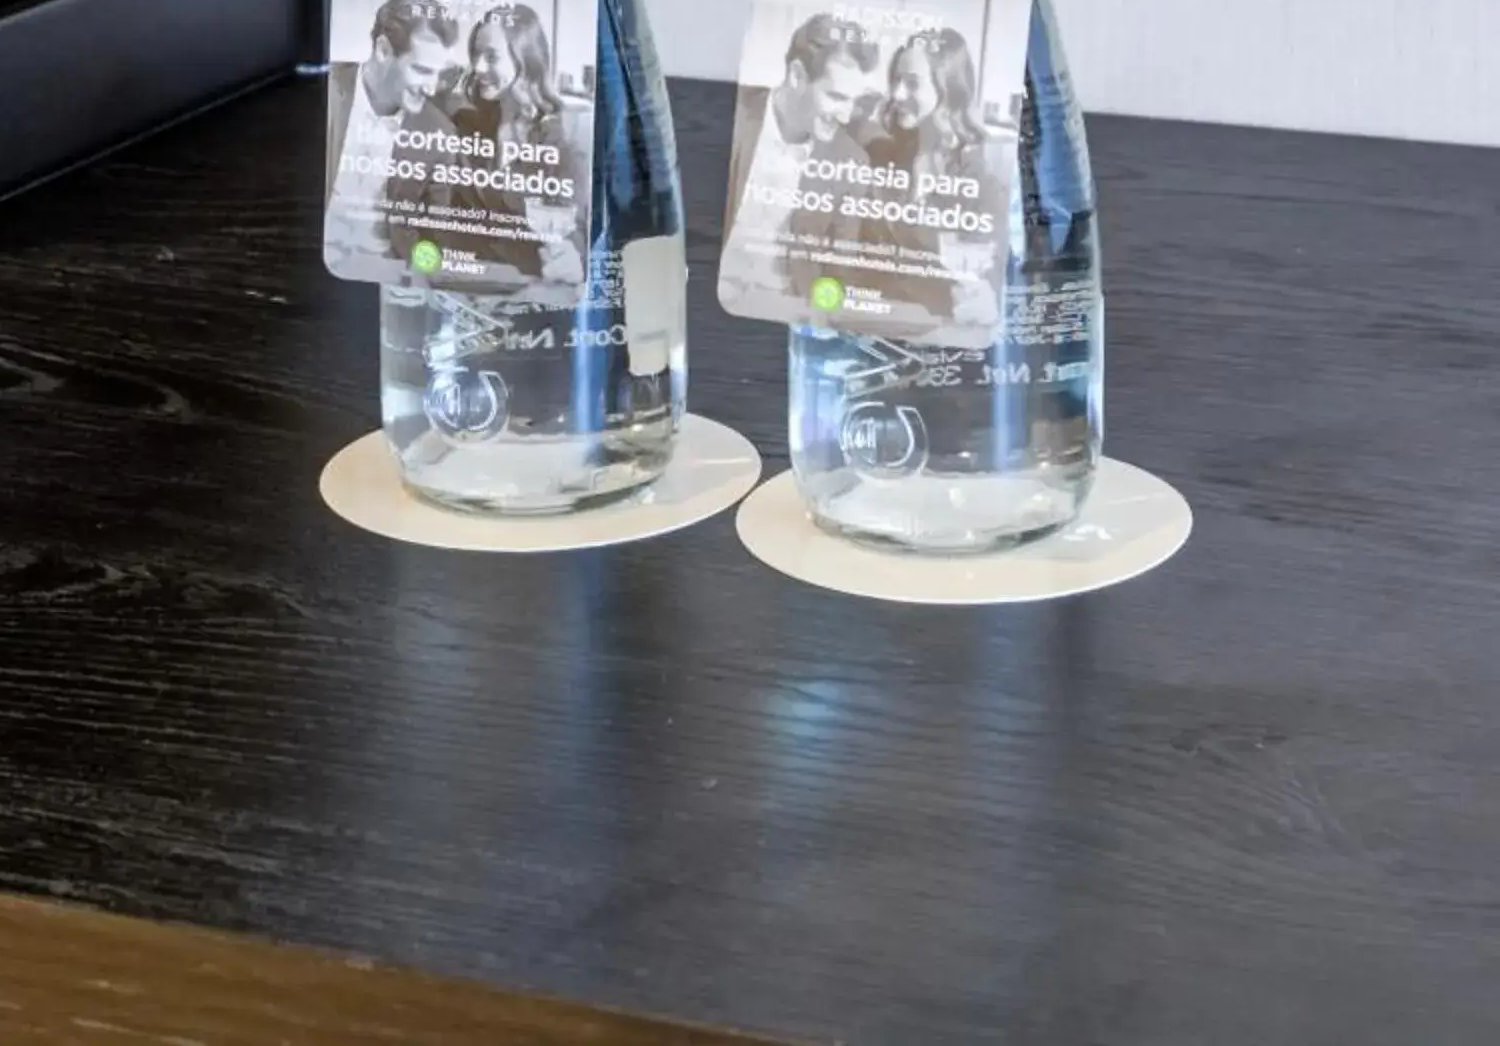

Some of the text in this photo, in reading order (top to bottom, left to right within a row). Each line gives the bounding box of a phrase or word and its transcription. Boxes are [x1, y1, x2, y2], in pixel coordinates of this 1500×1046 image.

[394, 128, 495, 157] cortesia
[502, 141, 560, 166] para
[341, 154, 575, 197] nossos associados
[803, 158, 910, 190] cortesia
[917, 173, 980, 200] para
[840, 194, 995, 234] associados
[441, 260, 486, 275] PLANET
